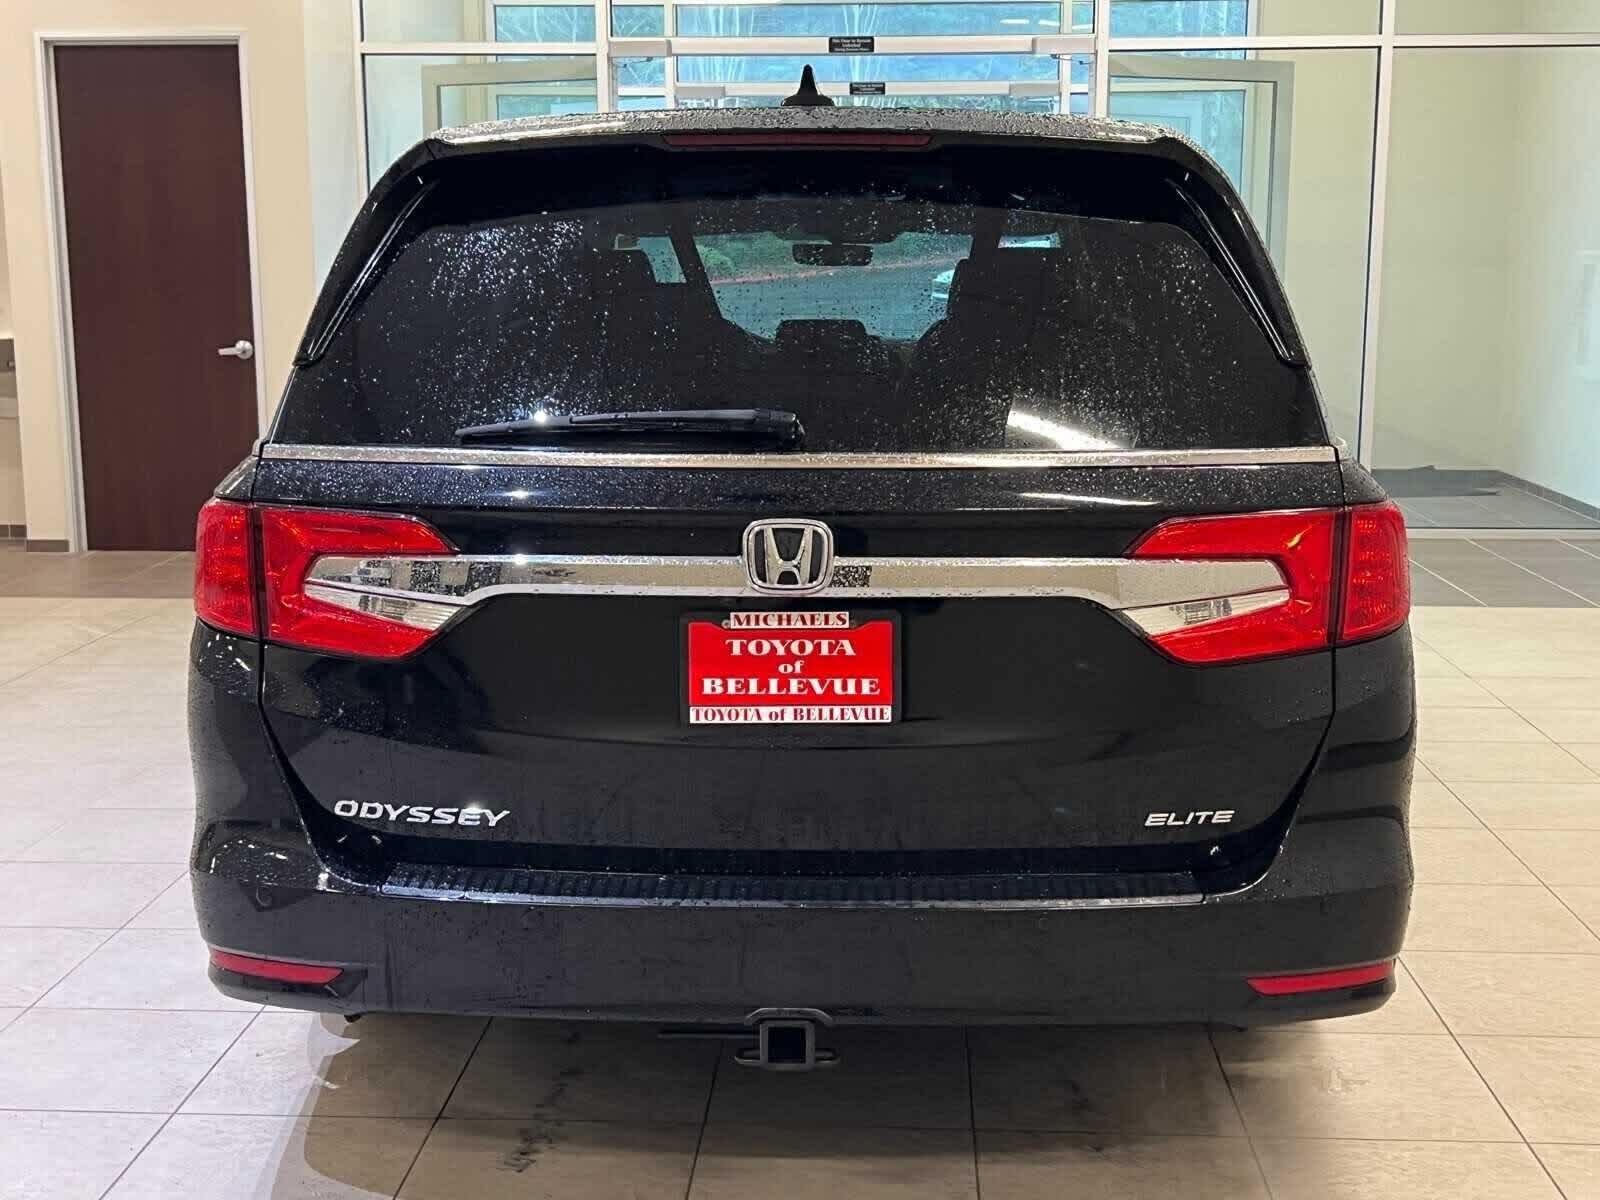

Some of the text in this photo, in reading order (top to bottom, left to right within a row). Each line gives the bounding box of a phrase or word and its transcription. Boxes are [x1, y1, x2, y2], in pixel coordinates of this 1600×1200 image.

[733, 613, 848, 627] MICHAELS
[725, 639, 856, 656] TOYOTA
[778, 660, 805, 674] of
[702, 678, 881, 695] BELLEVUE
[692, 707, 889, 722] TOYOTA of BELLEVUE
[334, 800, 510, 827] ODYSSEY
[1144, 810, 1235, 826] ELITE
